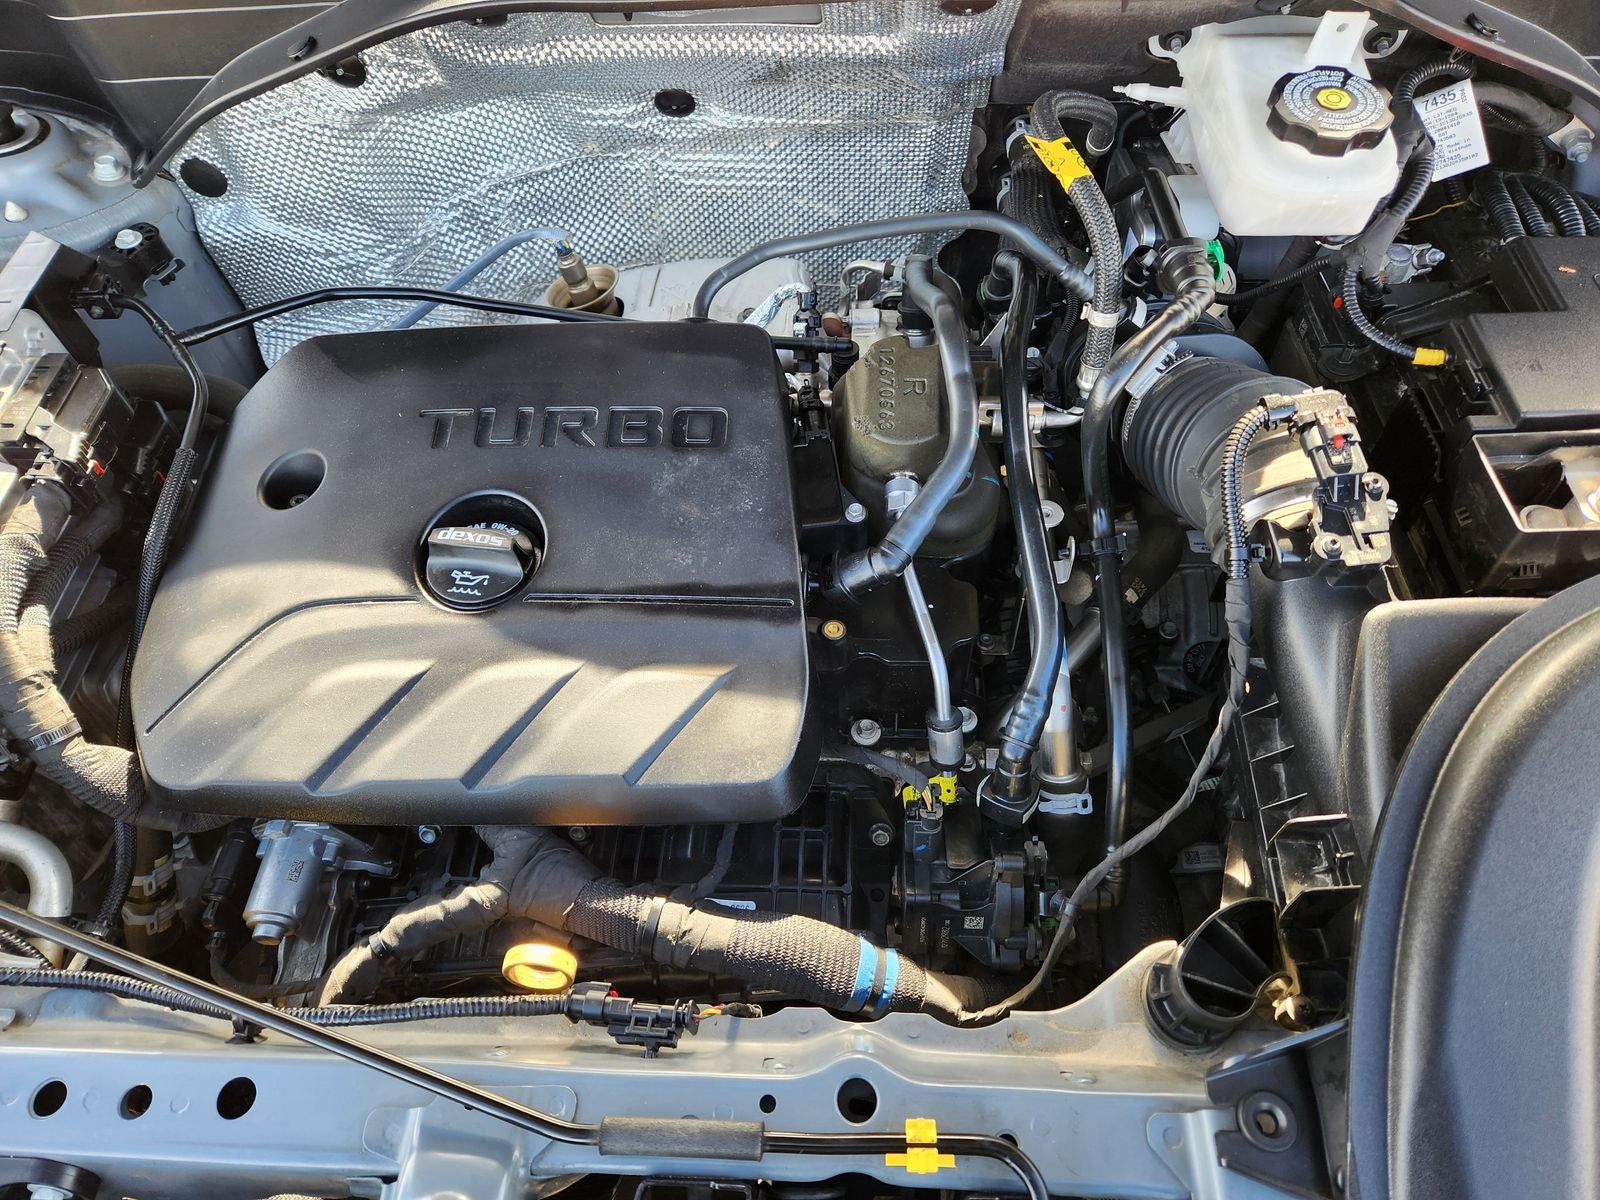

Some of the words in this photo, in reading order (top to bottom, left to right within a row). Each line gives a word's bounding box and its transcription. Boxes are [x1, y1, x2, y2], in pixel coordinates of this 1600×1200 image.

[1422, 89, 1456, 111] 7435
[903, 378, 928, 396] R
[419, 405, 728, 449] TURBO
[437, 527, 504, 547] dexos
